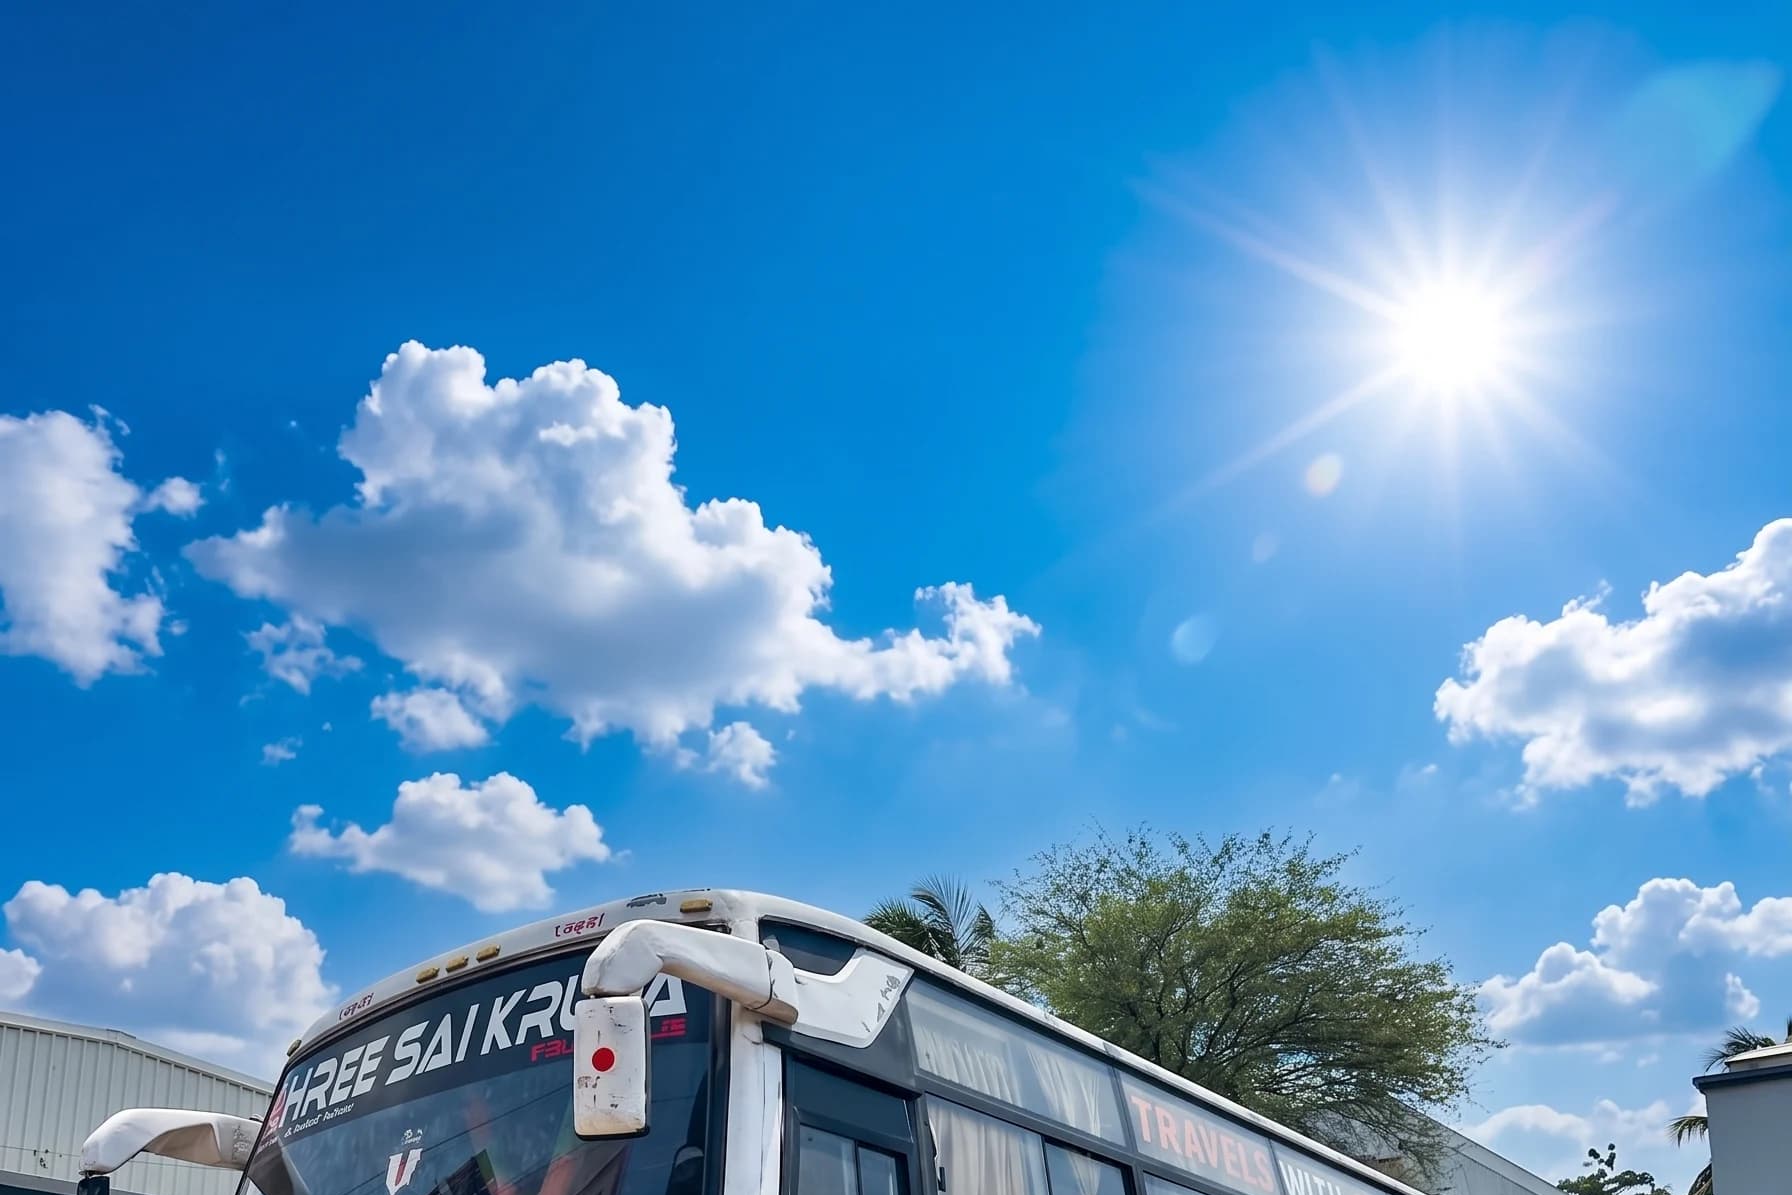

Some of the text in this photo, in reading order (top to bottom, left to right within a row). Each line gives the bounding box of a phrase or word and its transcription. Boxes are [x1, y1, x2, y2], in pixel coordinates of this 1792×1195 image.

[385, 1003, 480, 1086] SAI
[480, 972, 688, 1056] KRUA
[1132, 1095, 1274, 1193] TRAVELS
